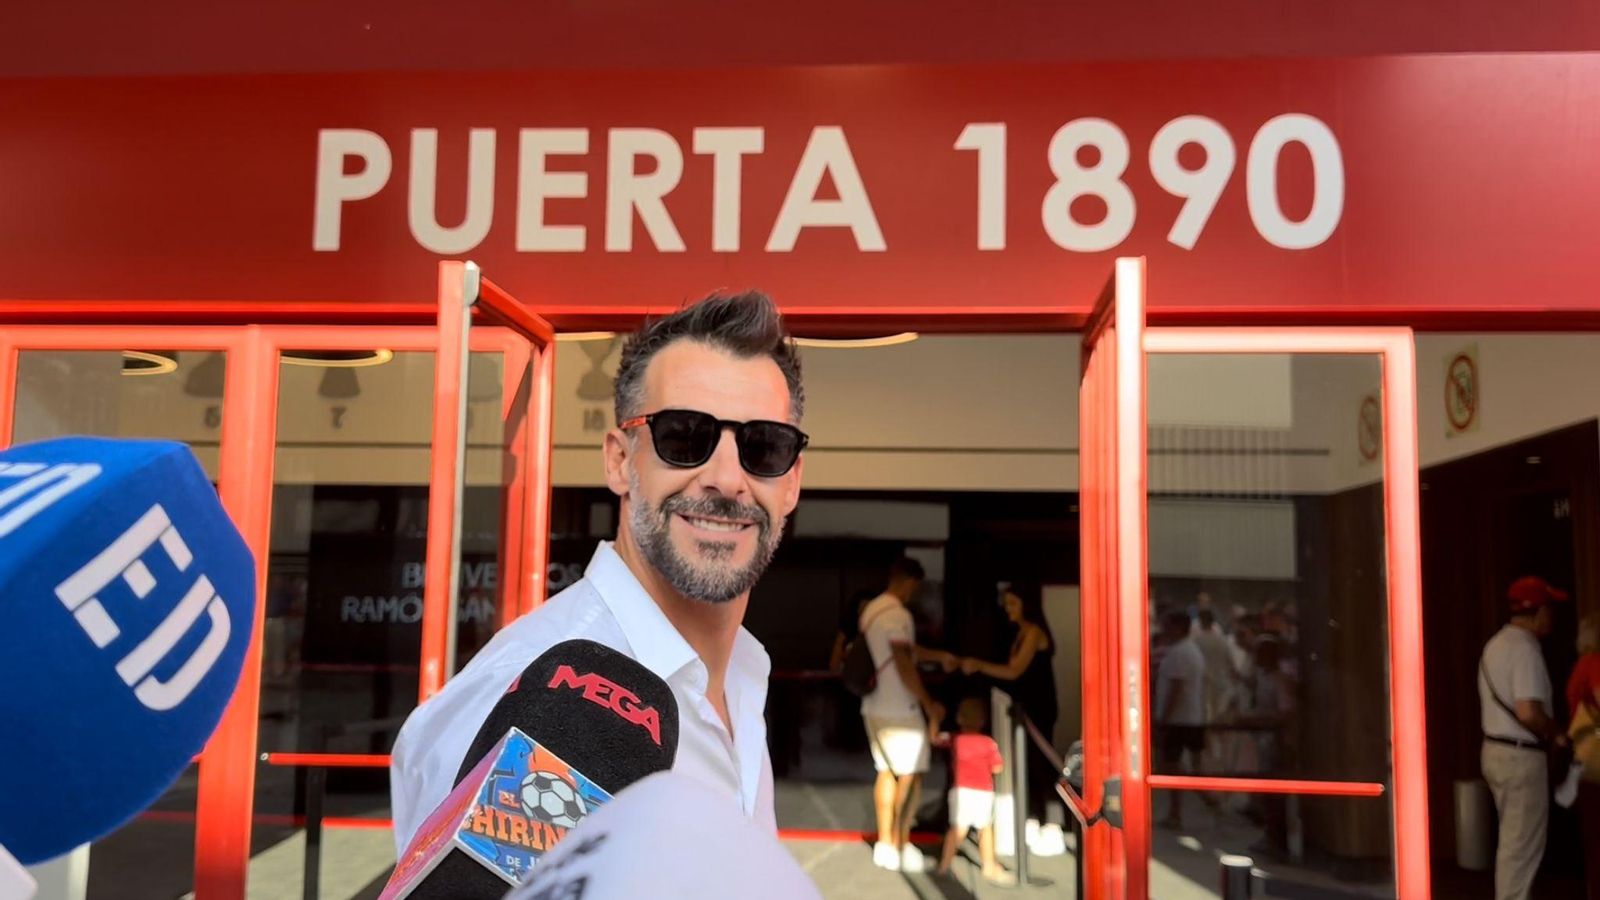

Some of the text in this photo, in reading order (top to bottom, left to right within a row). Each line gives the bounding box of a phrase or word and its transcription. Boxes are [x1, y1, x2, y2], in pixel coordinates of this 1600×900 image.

[312, 113, 1345, 254] PUERTA 1890
[55, 503, 231, 711] ED
[340, 592, 424, 624] RAMÓ
[547, 665, 662, 747] MEGA
[505, 854, 522, 869] DE
